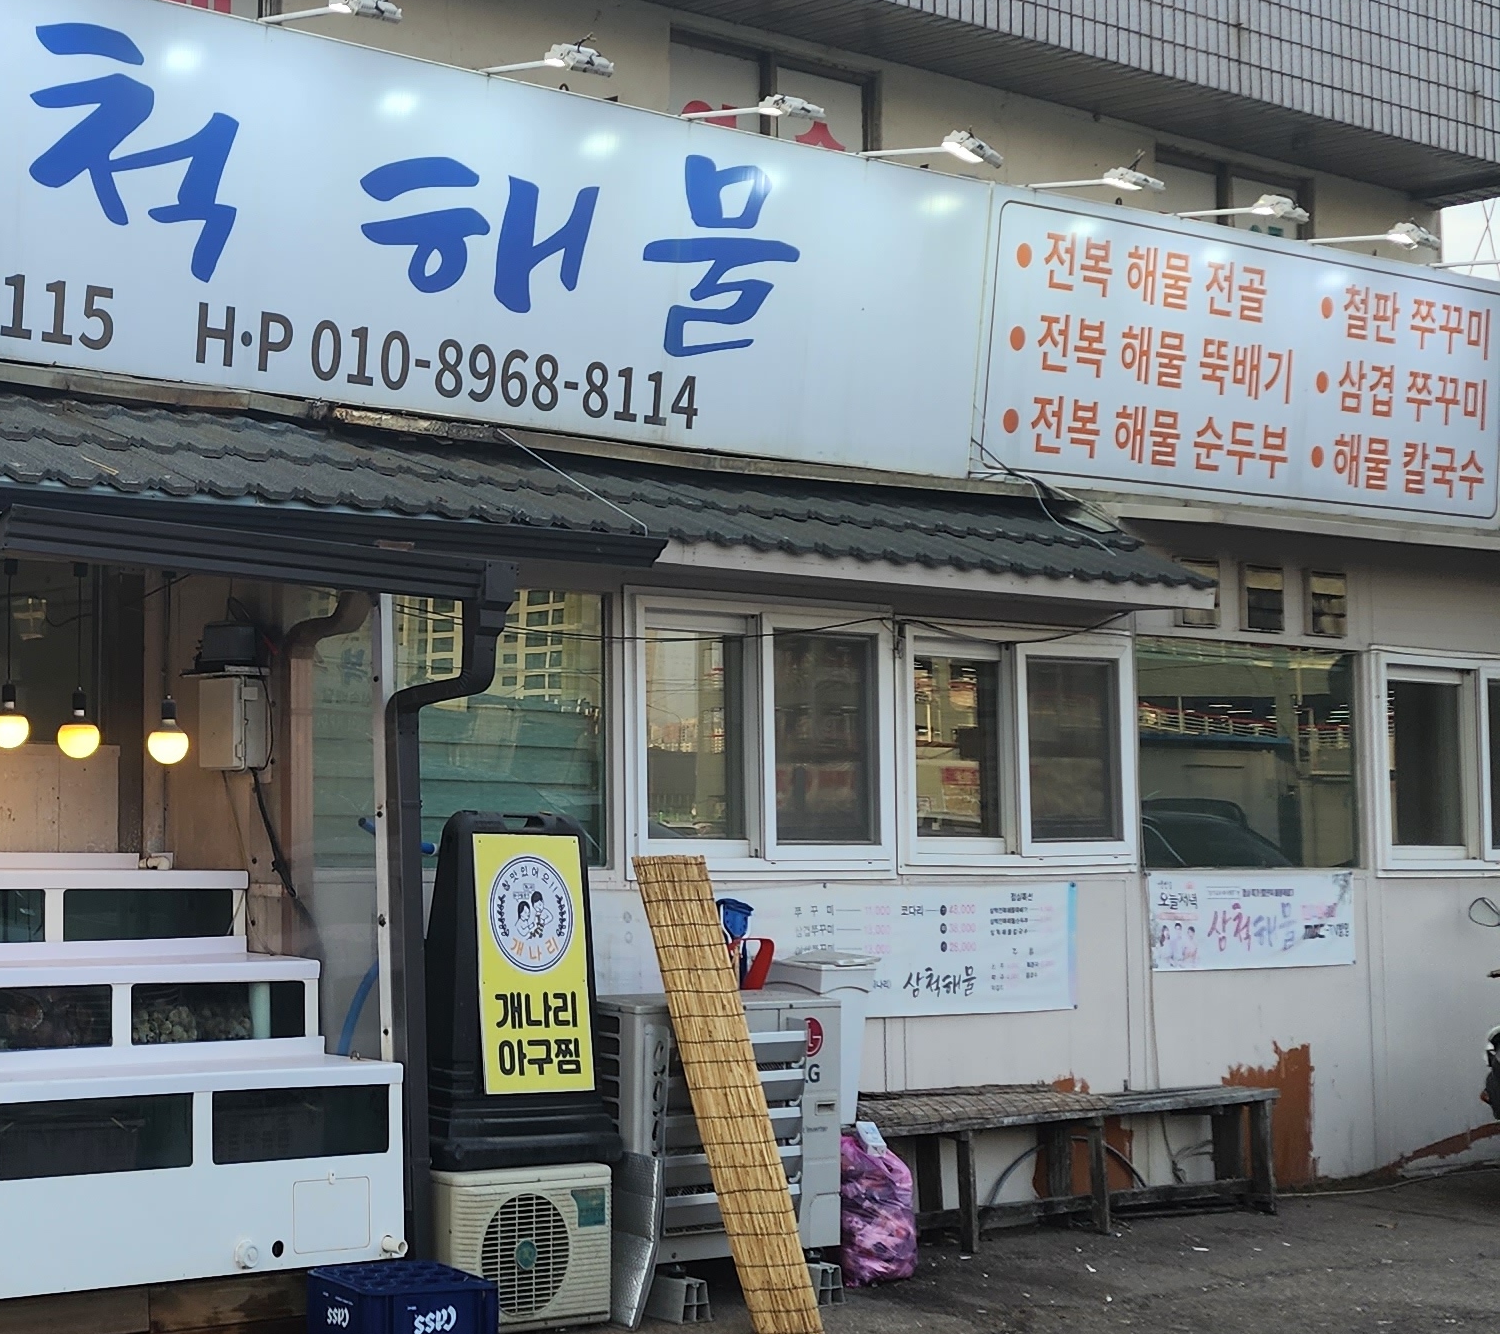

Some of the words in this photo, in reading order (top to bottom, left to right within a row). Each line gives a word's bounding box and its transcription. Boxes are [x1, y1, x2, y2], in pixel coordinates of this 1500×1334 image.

[1043, 231, 1114, 298] 전복
[1127, 245, 1192, 310] 해물
[1206, 260, 1267, 323] 전골
[1344, 285, 1400, 342] 철판
[1411, 298, 1491, 360] 쭈꾸미
[310, 319, 698, 431] 010-8968-8114
[1037, 313, 1106, 378] 전복
[1120, 326, 1187, 389] 해물
[1199, 337, 1294, 405] 뚝배기
[1338, 360, 1395, 418] 삼겹
[1405, 370, 1487, 431] 쭈꾸미
[1030, 395, 1101, 458] 전복
[1115, 405, 1180, 468] 해물
[1193, 416, 1289, 479] 순두부
[1333, 433, 1391, 490] 해물
[1404, 441, 1485, 500] 칼국수
[901, 906, 923, 915] 코다리
[1158, 893, 1198, 909] 오늘저녁
[495, 992, 578, 1029] 개나리
[497, 1039, 581, 1078] 아구찜
